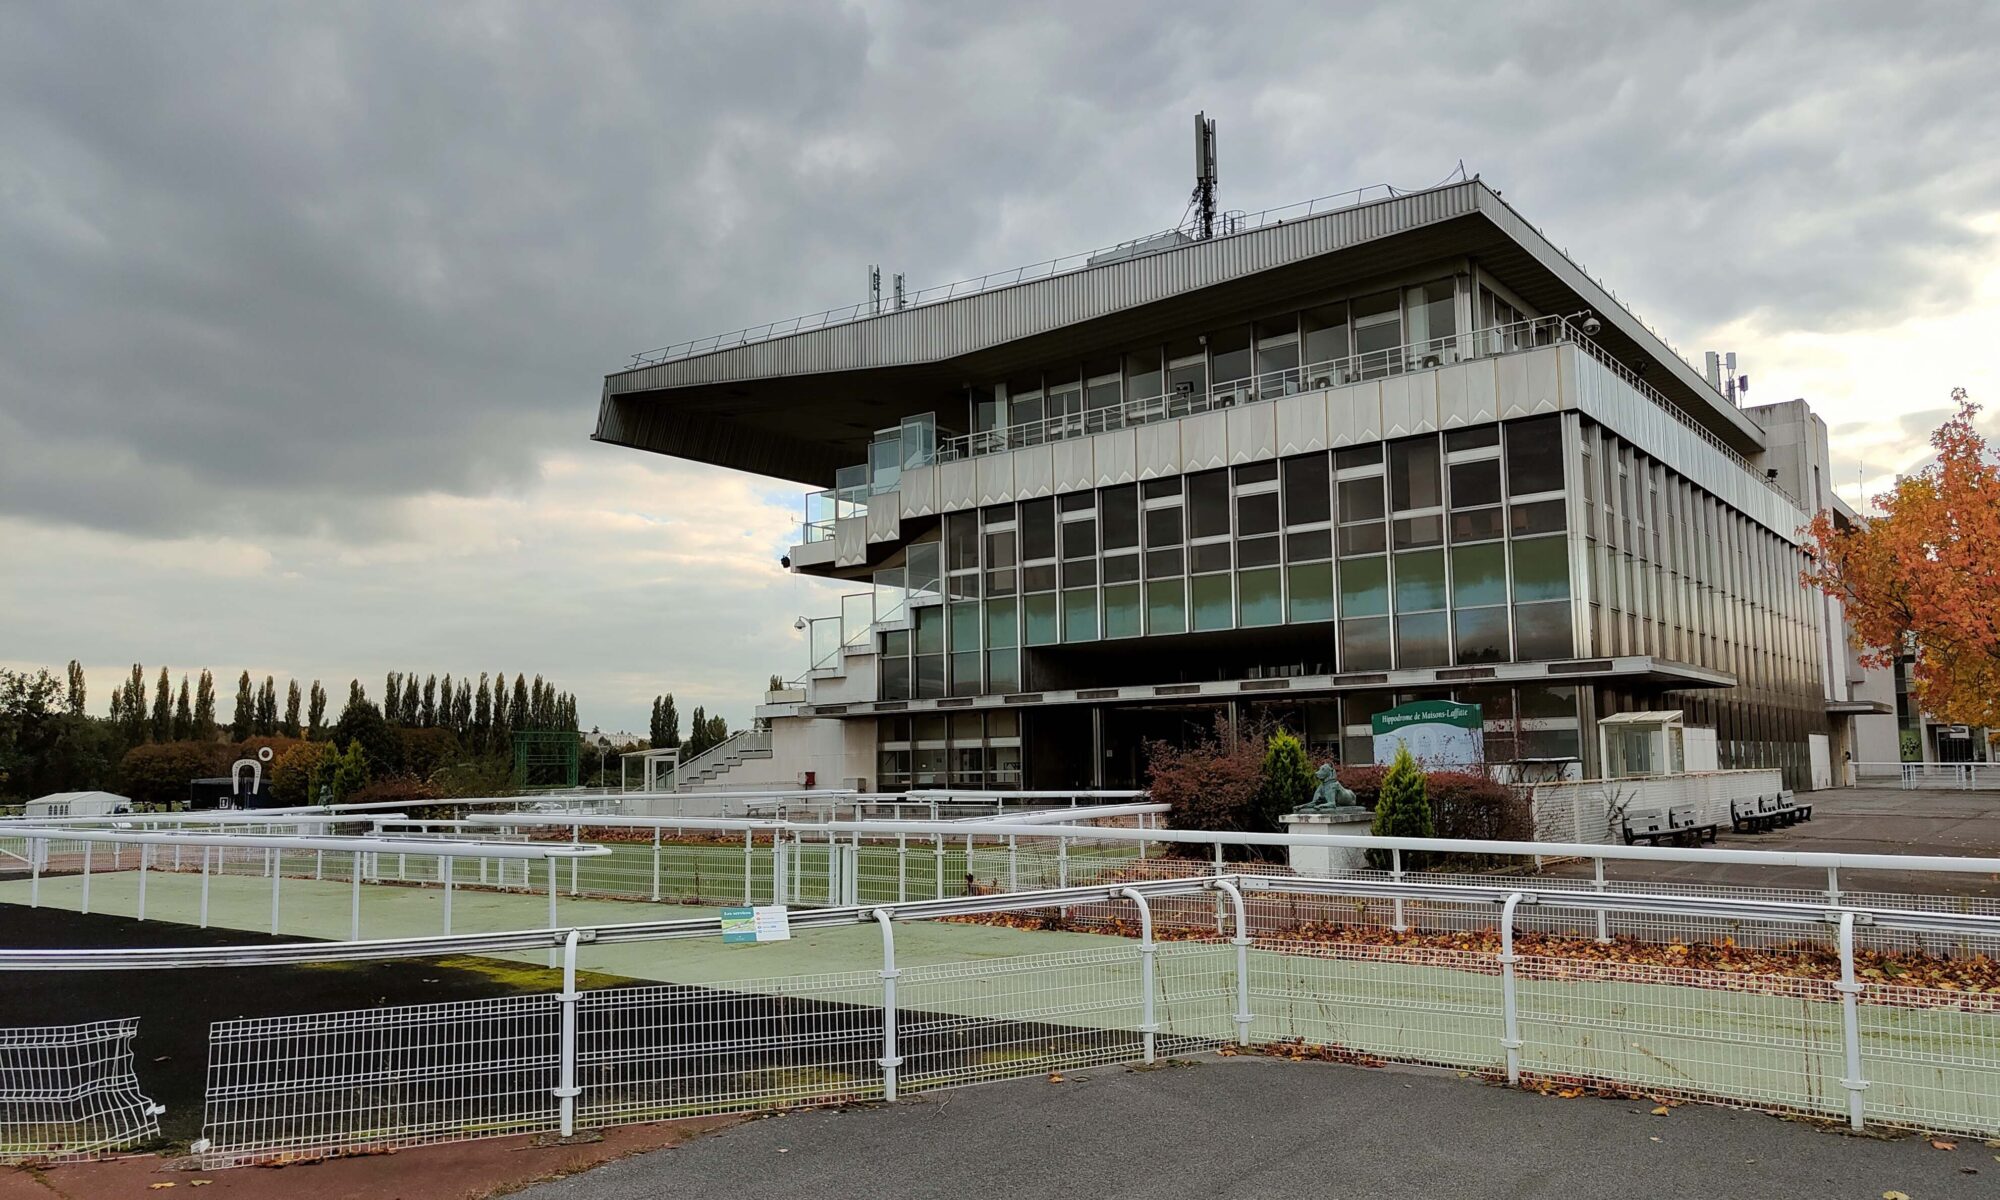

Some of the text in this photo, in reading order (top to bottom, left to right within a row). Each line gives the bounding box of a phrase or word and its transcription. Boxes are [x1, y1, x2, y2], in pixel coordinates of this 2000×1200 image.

[1382, 708, 1468, 725] Hippodrome de Maisons-Laffitte
